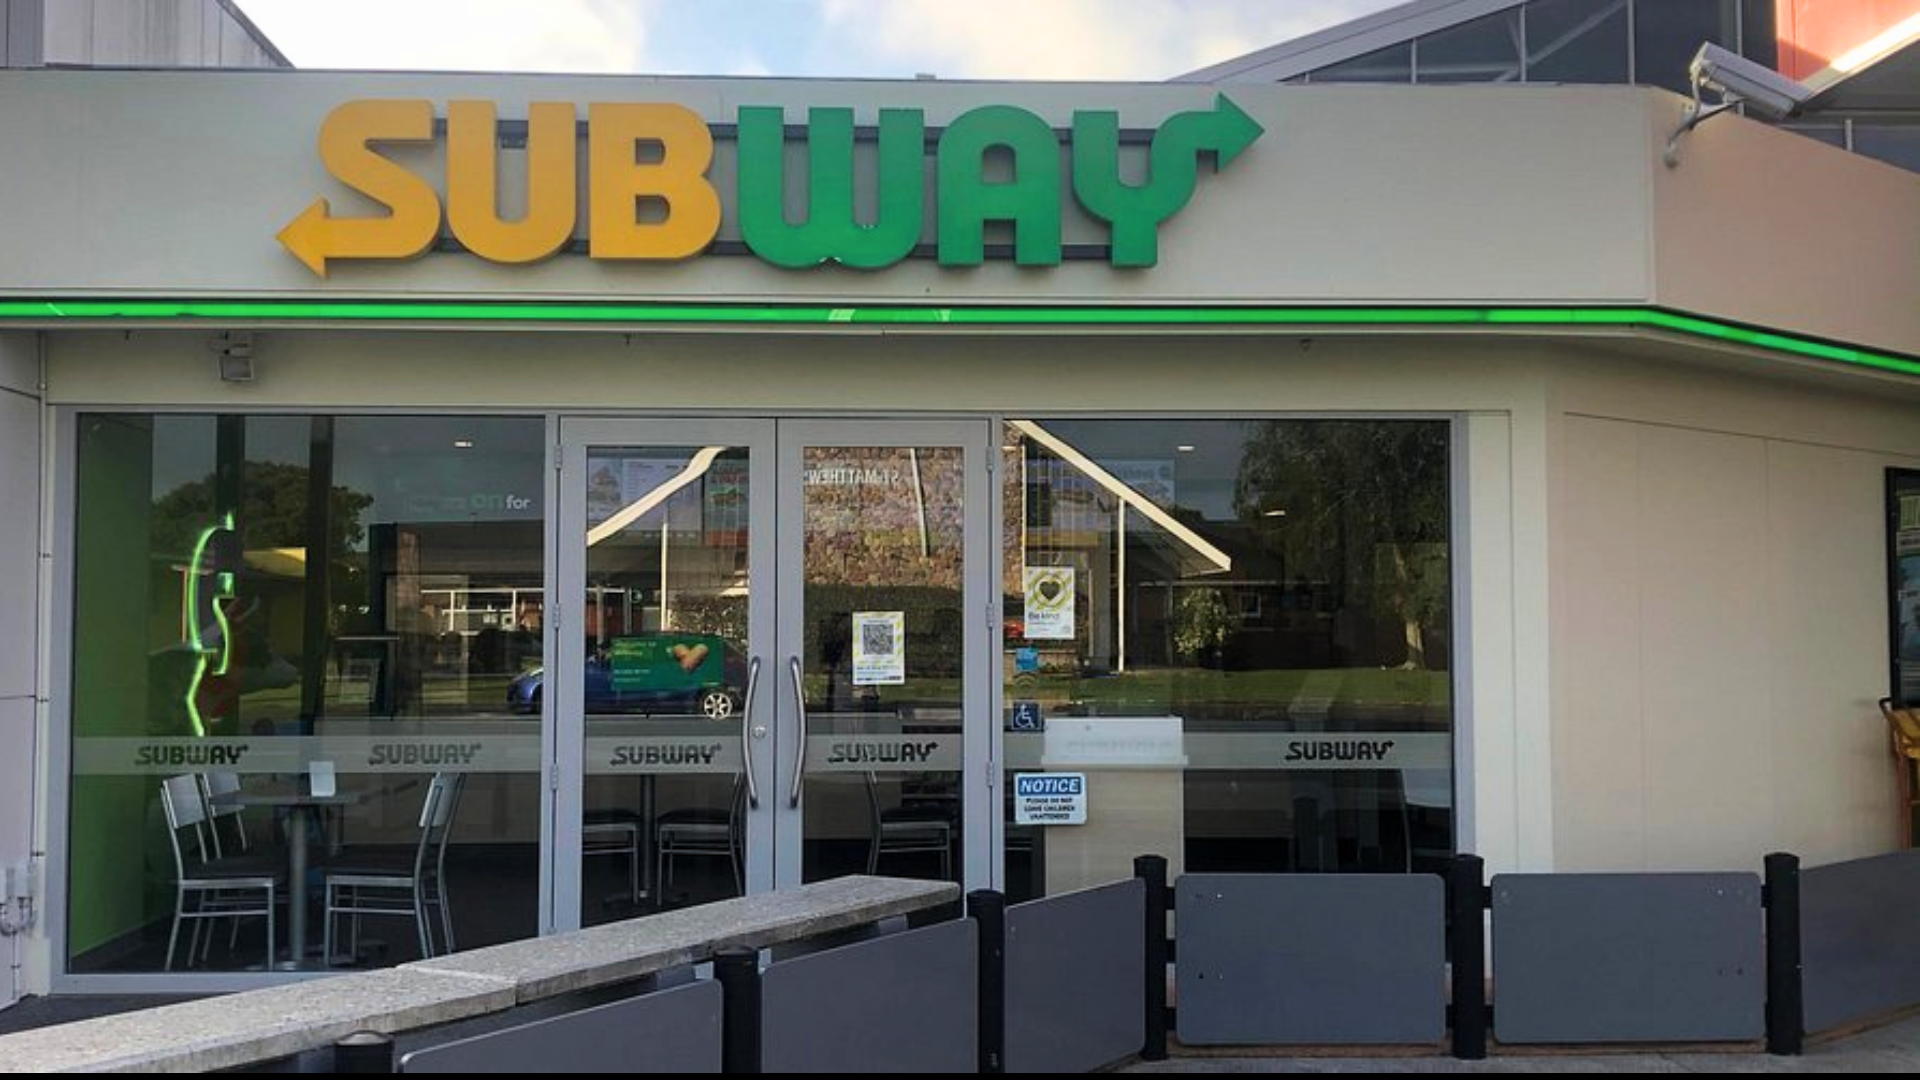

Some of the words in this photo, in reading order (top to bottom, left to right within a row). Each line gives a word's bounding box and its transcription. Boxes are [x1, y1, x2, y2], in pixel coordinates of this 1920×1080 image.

[274, 91, 1265, 279] SUBWAY
[505, 494, 531, 509] for
[135, 744, 249, 765] SUBWAY
[368, 743, 482, 765] SUBWAY
[609, 742, 722, 766] SUBWAY
[827, 742, 938, 763] SUBWAY
[1284, 740, 1394, 761] SUBWAY
[1020, 778, 1079, 793] NOTICE
